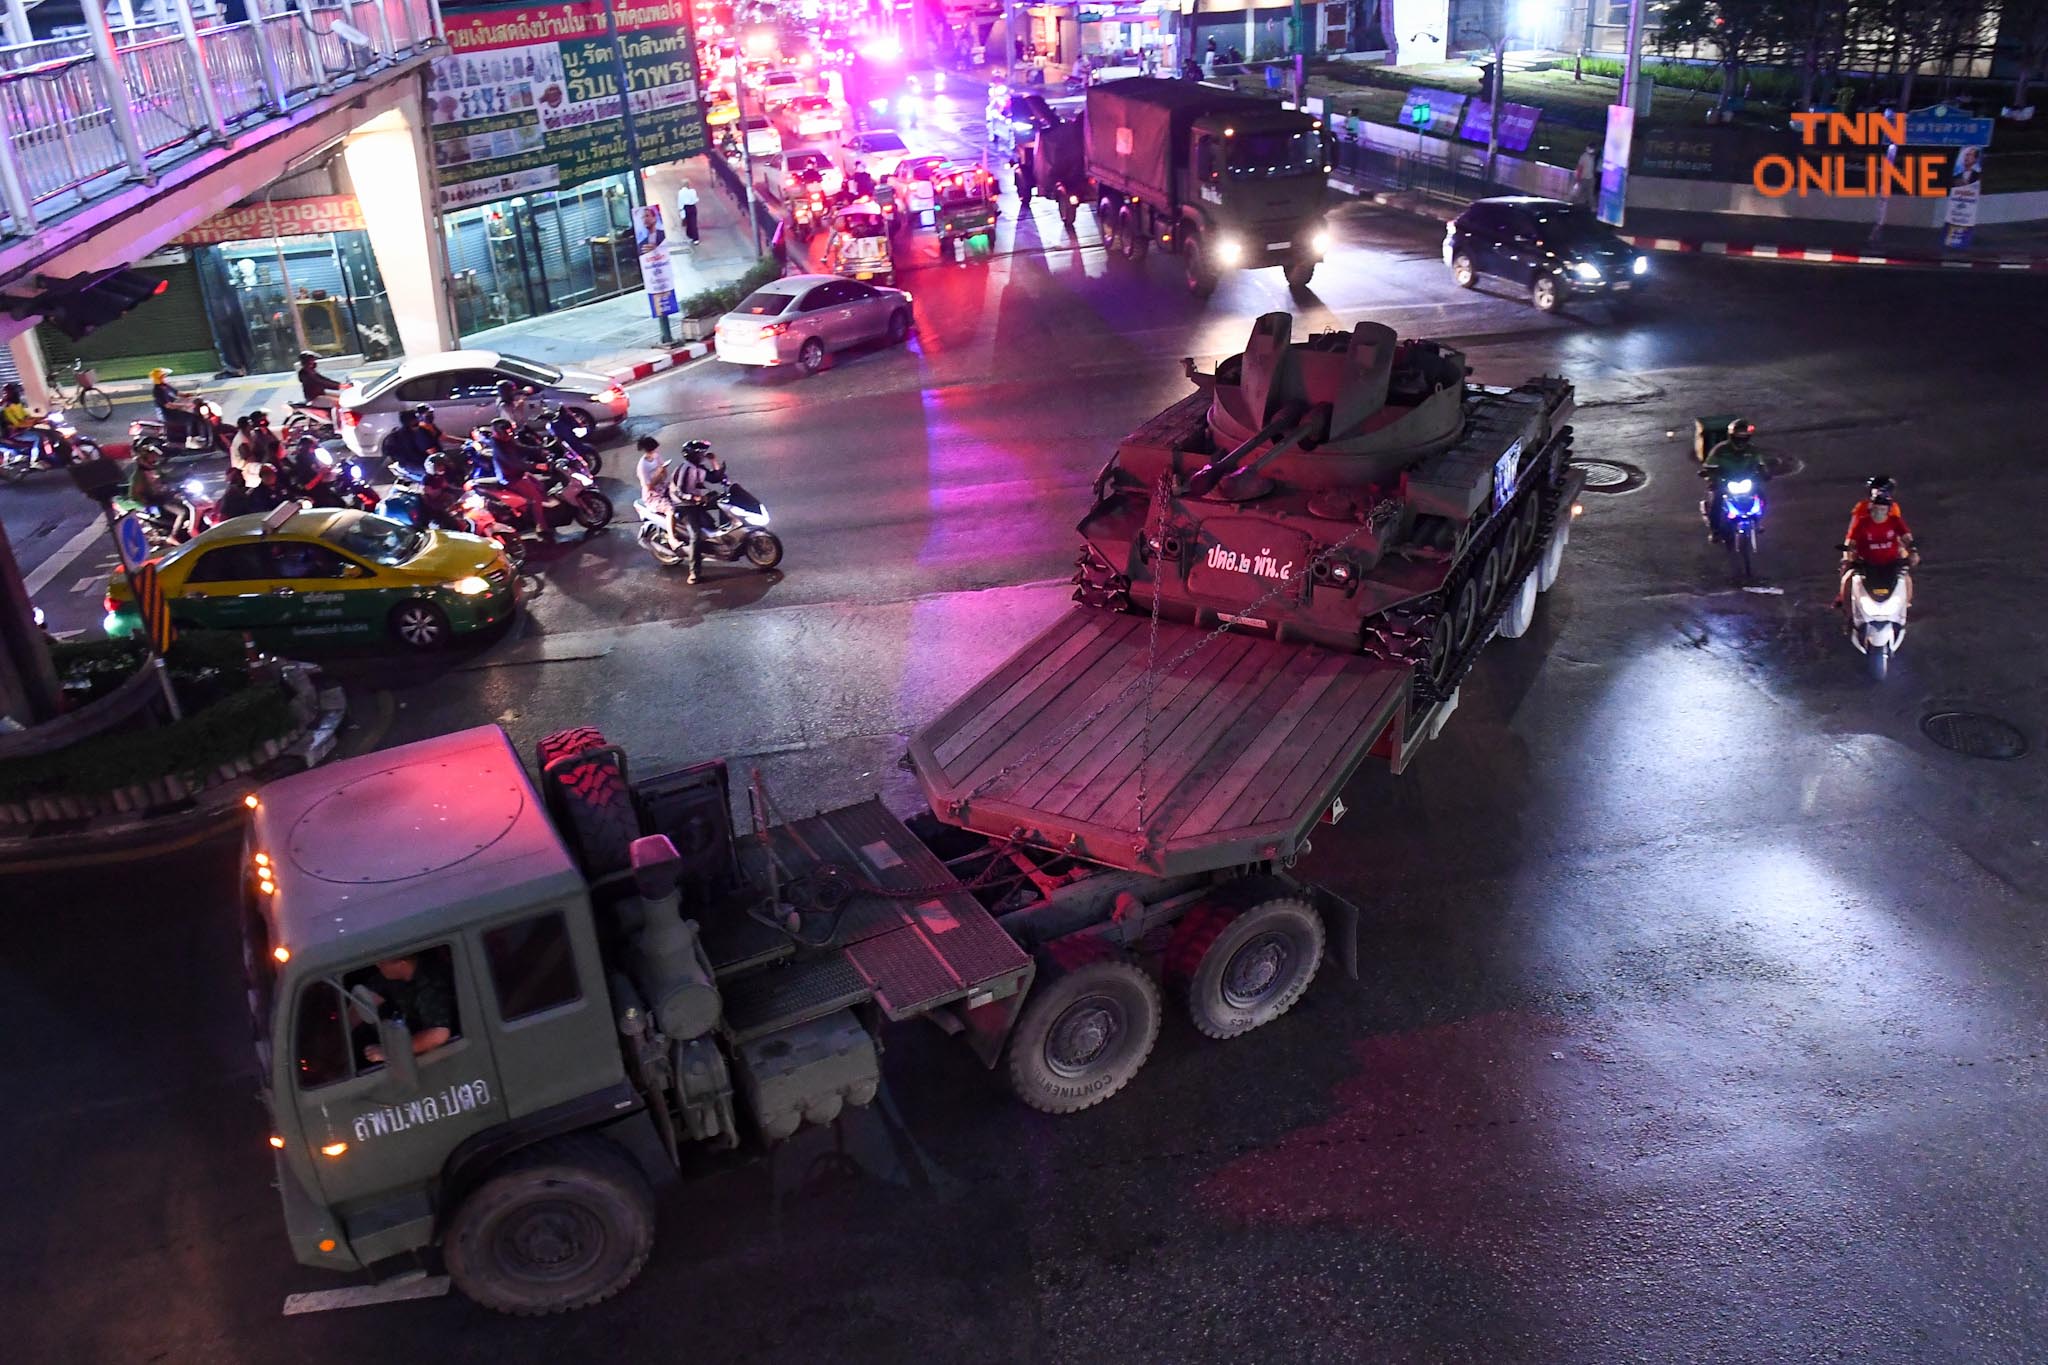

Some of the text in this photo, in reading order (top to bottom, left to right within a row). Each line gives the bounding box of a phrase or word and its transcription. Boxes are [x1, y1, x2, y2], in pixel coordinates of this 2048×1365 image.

[671, 122, 702, 140] 1425
[1207, 543, 1293, 580] ปตอ.๒ พัน.๔
